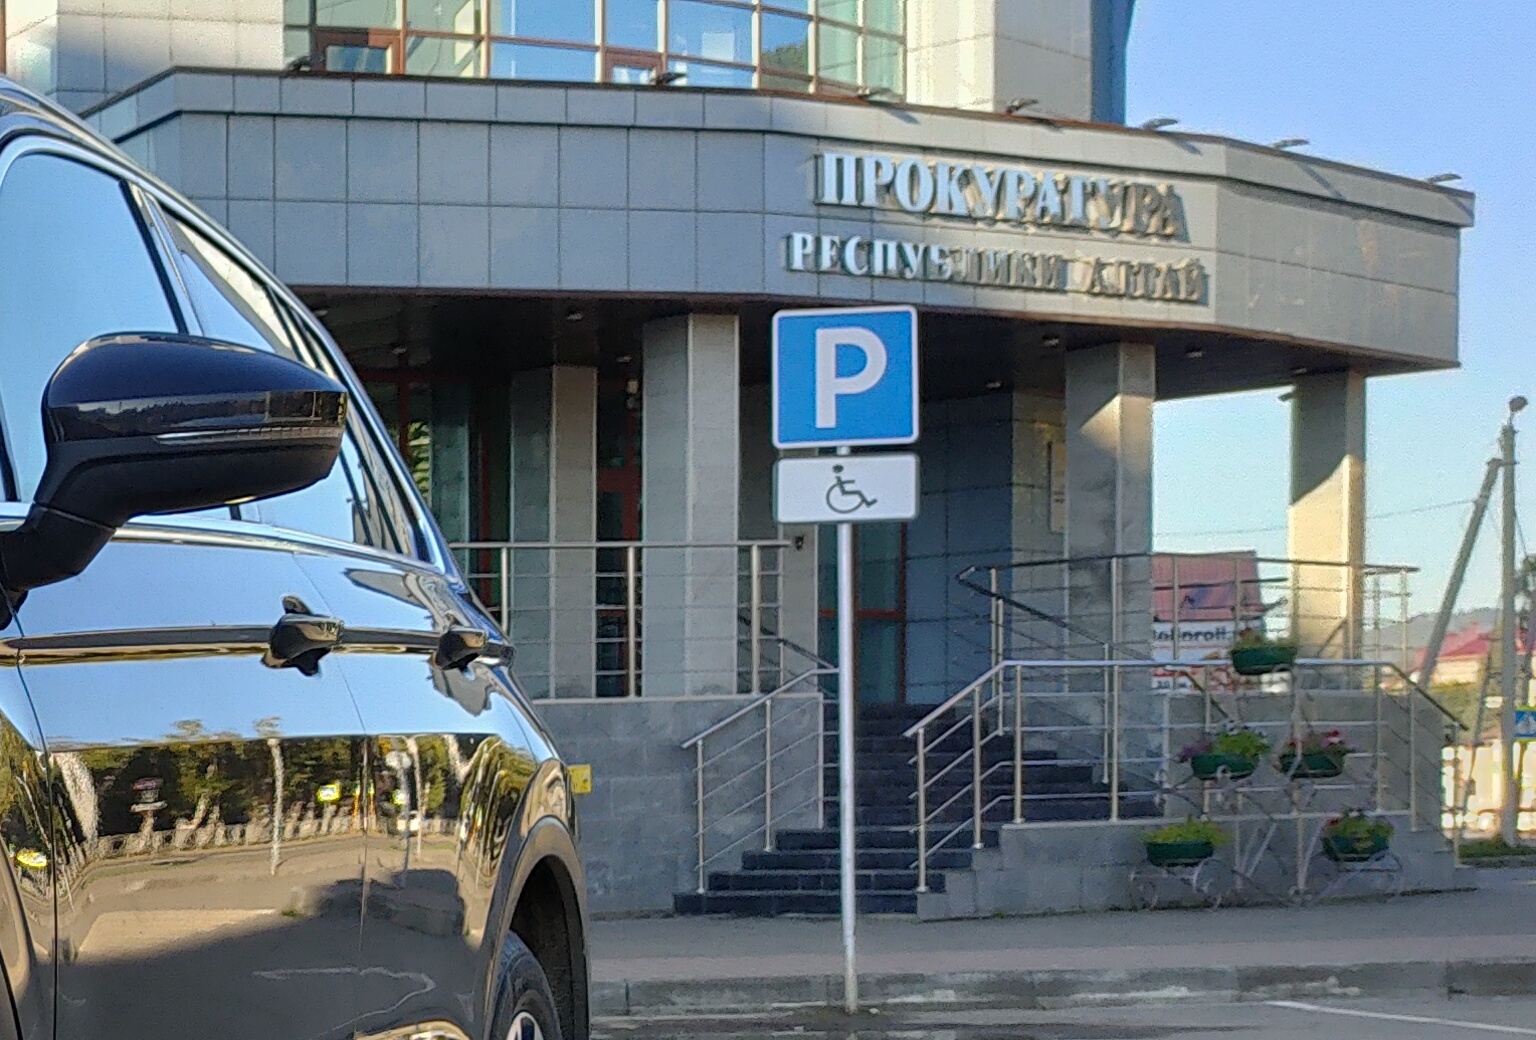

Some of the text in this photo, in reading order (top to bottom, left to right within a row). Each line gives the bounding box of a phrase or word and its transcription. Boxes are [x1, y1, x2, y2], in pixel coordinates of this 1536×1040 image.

[818, 151, 1186, 238] ПРОКУРАТУРА
[788, 231, 1206, 301] РЕСПУБЛИКИ АЛТАЙ
[815, 327, 888, 429] P
